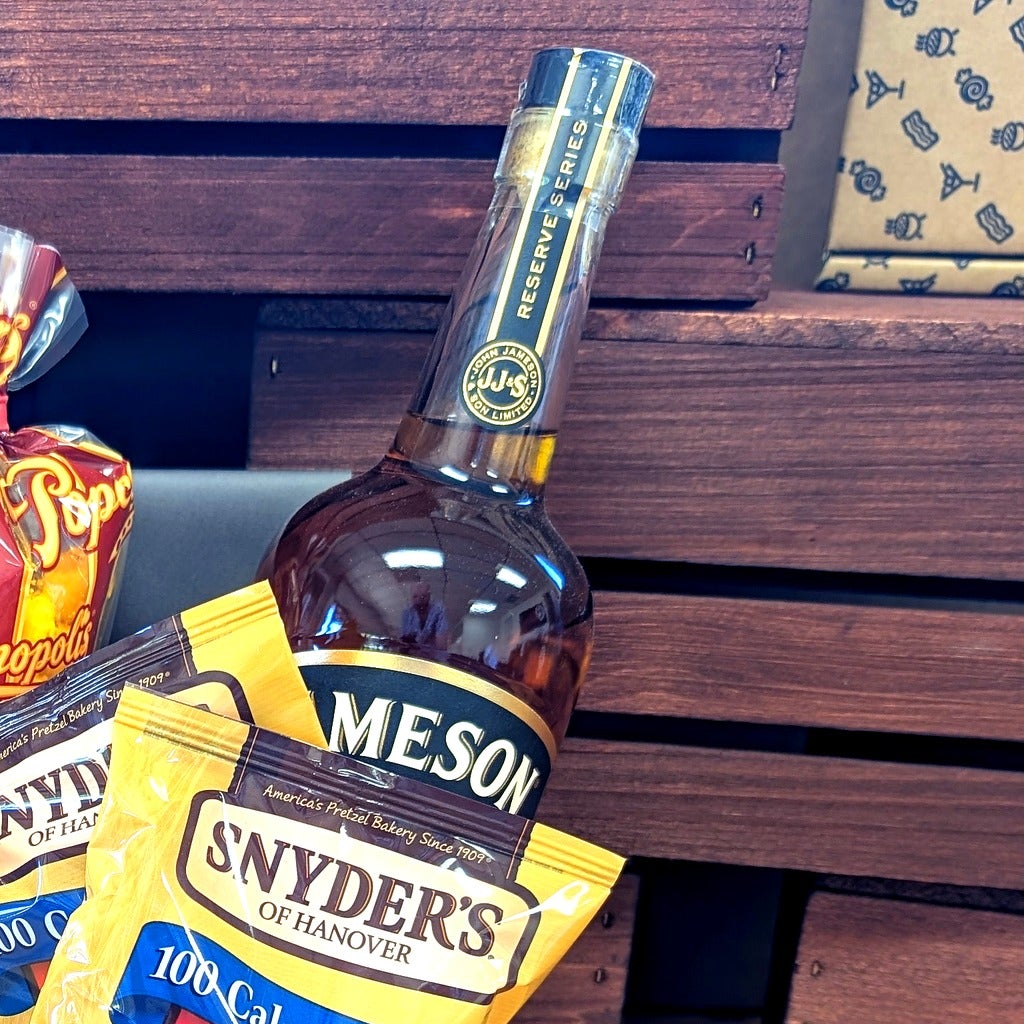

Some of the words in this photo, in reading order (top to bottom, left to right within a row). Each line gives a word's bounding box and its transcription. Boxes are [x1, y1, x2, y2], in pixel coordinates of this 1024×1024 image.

[517, 214, 559, 320] RESERVE
[549, 119, 588, 208] SERIES
[472, 348, 499, 374] JOHN
[502, 346, 538, 388] JAMESON
[469, 394, 491, 415] SON
[491, 396, 533, 420] LIMITED
[31, 716, 69, 742] Pretzel
[69, 699, 104, 723] Bakery
[106, 688, 124, 703] Sin
[329, 691, 541, 815] MESON
[28, 825, 56, 847] OF
[263, 783, 323, 812] America's
[325, 801, 370, 825] Pretzel
[371, 815, 417, 846] Bakery
[419, 832, 453, 854] Since
[457, 845, 485, 864] 1909
[205, 820, 505, 957] SNYDER'S
[259, 900, 292, 926] OF
[292, 912, 412, 965] HANOVER
[149, 945, 219, 996] 100
